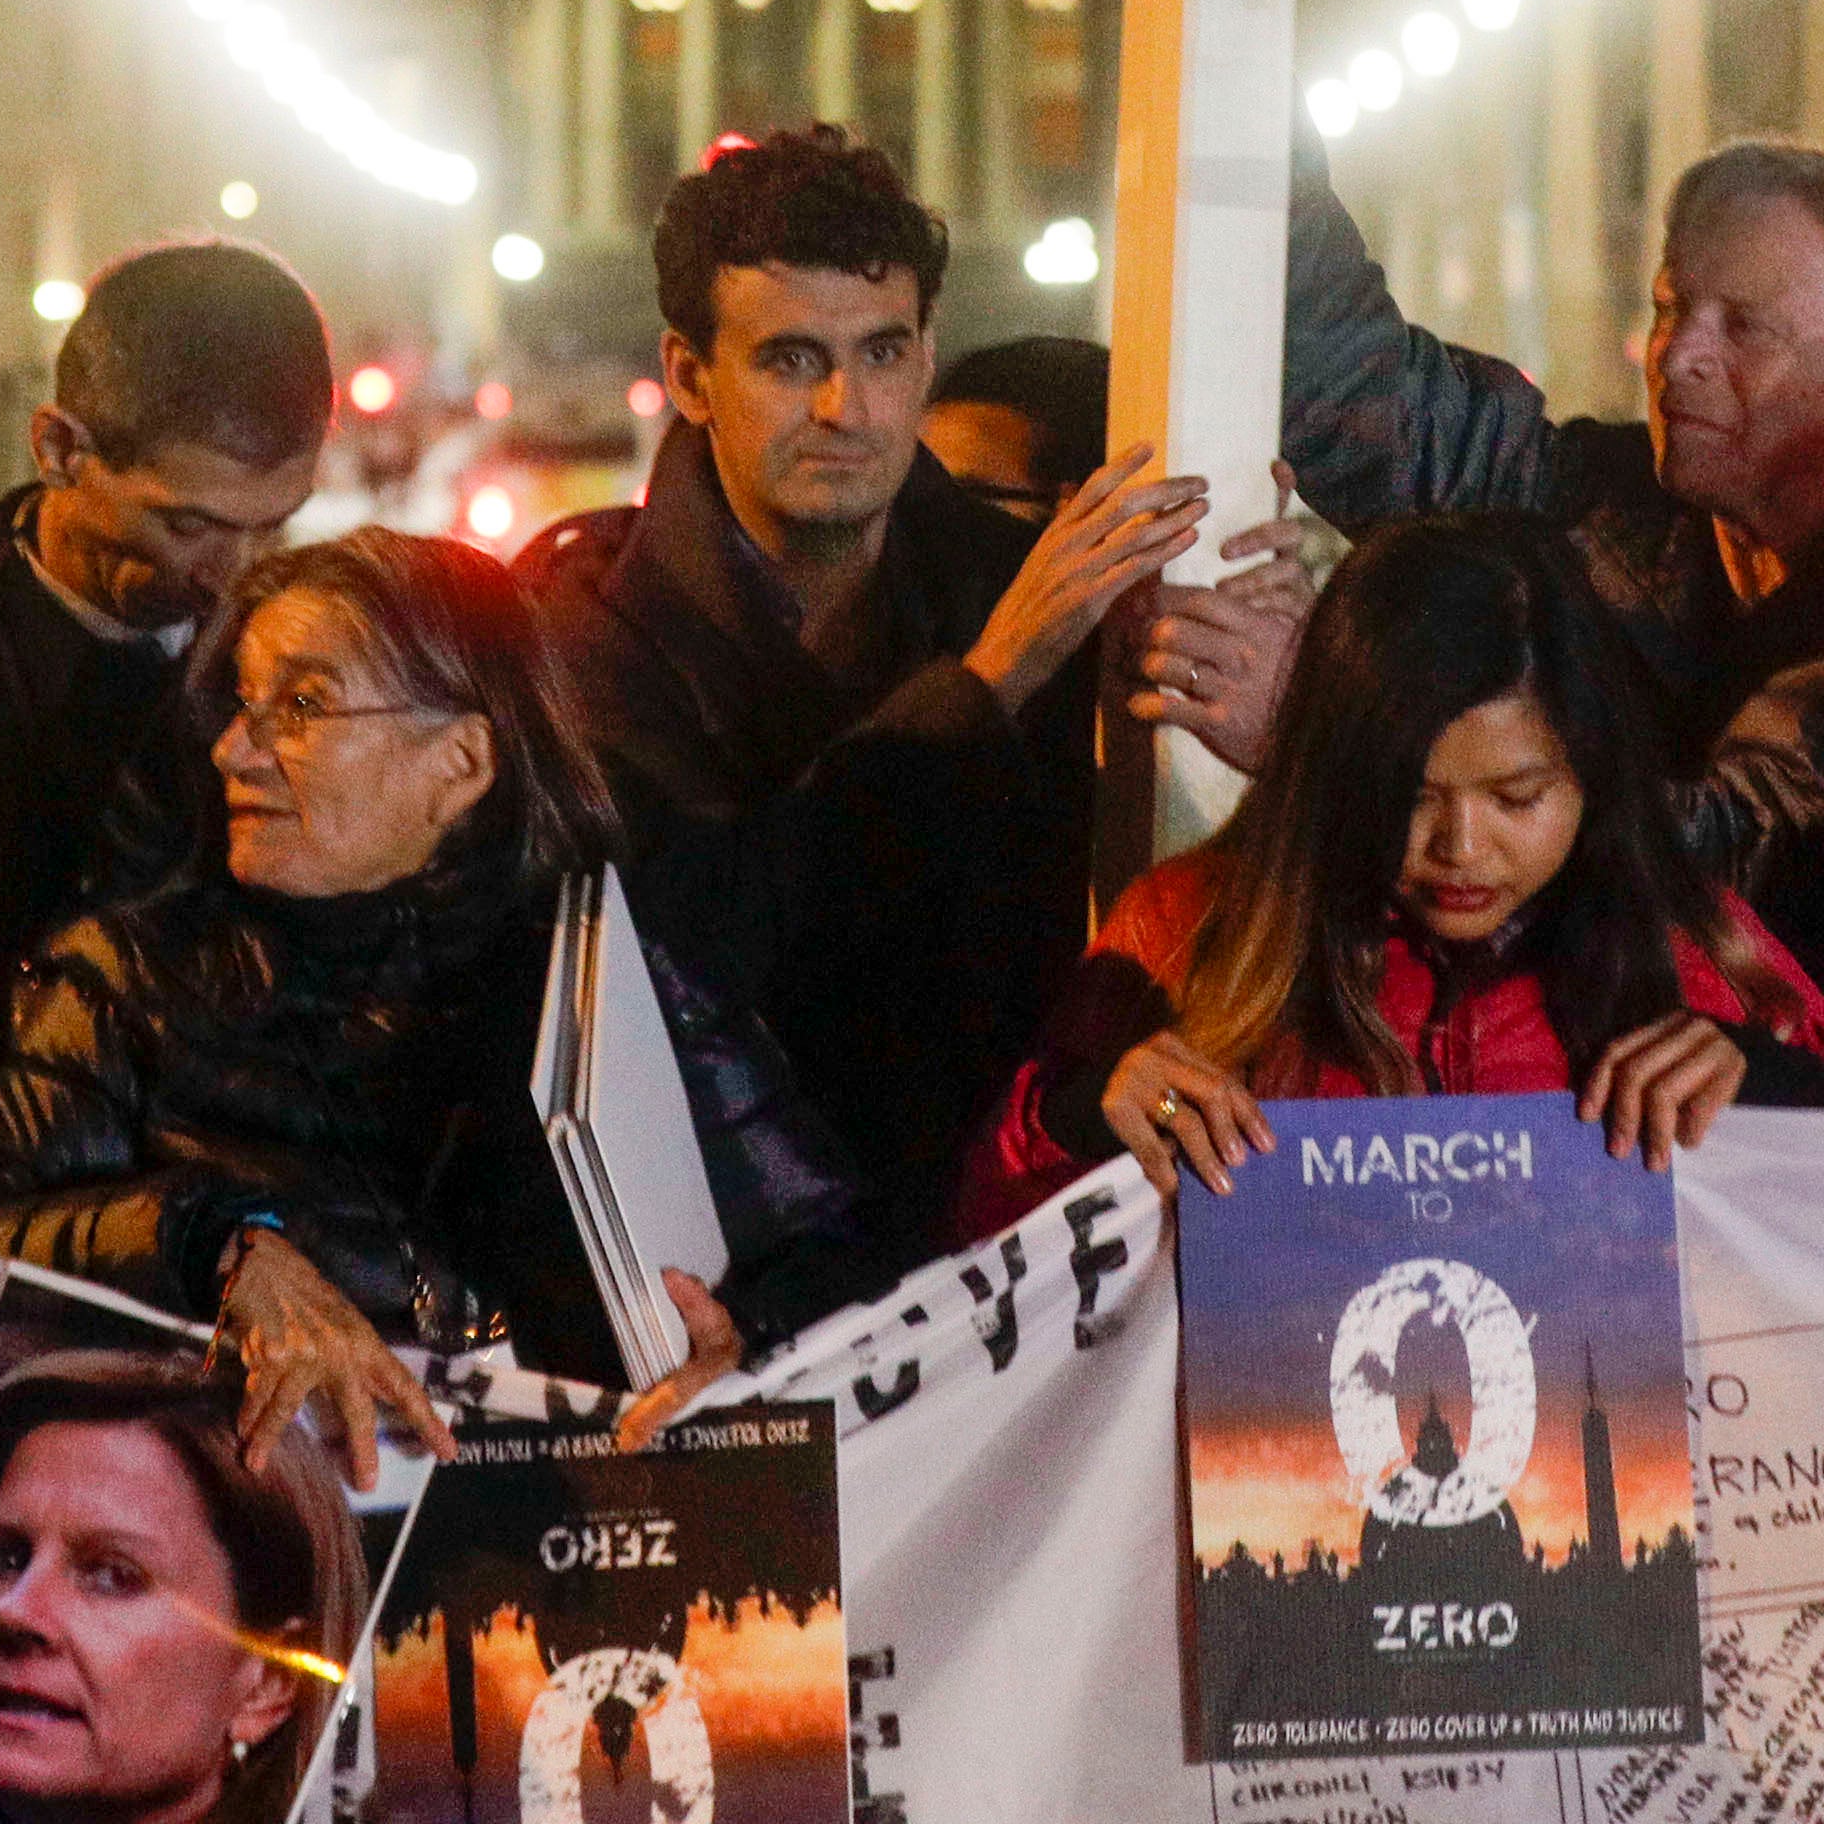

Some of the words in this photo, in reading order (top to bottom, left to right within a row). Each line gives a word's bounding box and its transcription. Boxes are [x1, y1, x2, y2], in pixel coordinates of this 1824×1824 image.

[1301, 1130, 1533, 1186] MARCH
[1409, 1192, 1453, 1224] TO
[539, 1519, 676, 1572] ZERO
[1373, 1602, 1519, 1651] ZERO
[1233, 1721, 1277, 1748] ZERO
[1283, 1717, 1369, 1745] TOLERANCE
[1386, 1716, 1431, 1742] ZERO
[1434, 1713, 1487, 1740] COVER
[1490, 1712, 1508, 1737] UP
[1528, 1711, 1579, 1737] TRUTH
[1583, 1709, 1613, 1735] AND
[1617, 1707, 1683, 1734] JUSTICE
